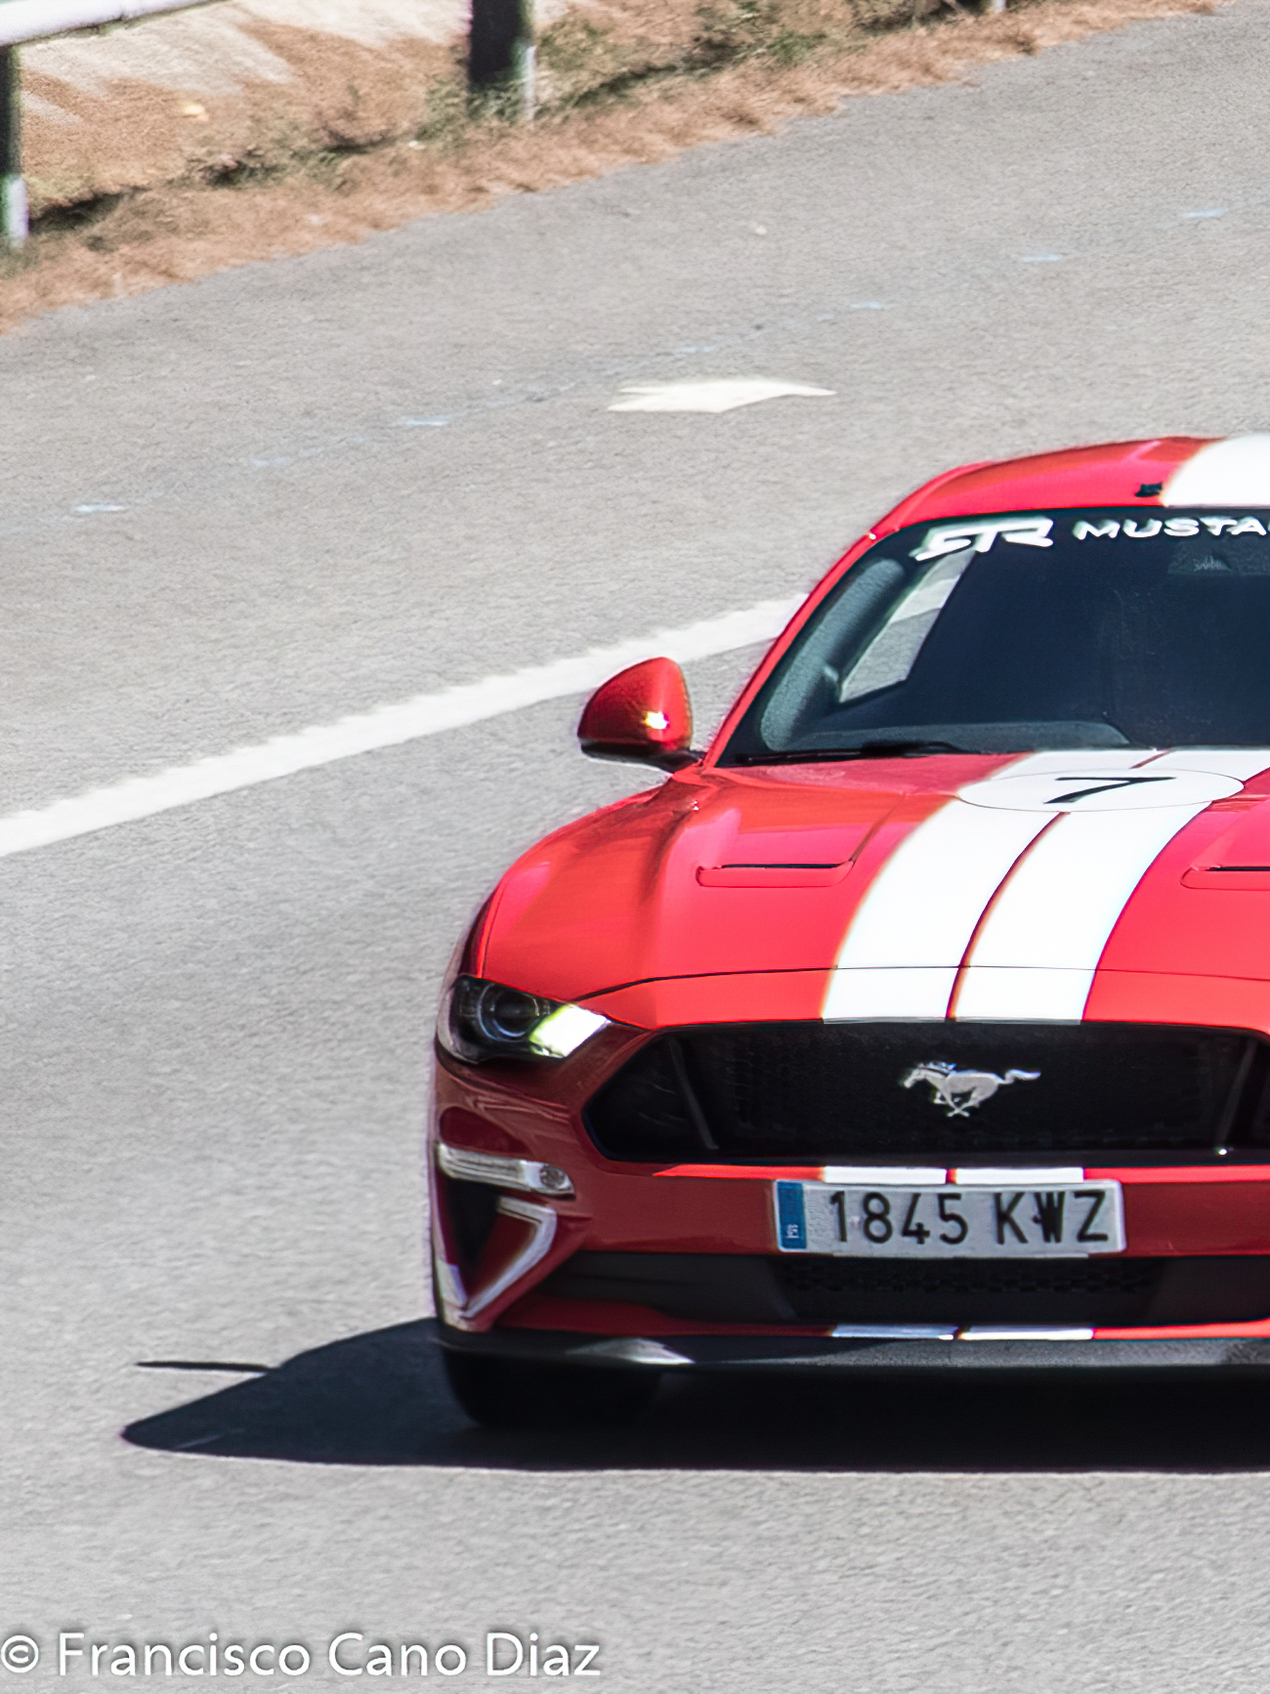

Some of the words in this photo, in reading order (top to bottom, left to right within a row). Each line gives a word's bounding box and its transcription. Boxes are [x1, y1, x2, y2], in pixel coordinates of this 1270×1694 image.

[1043, 776, 1177, 805] 7
[829, 1190, 968, 1244] 1845
[995, 1190, 1109, 1244] KWZ
